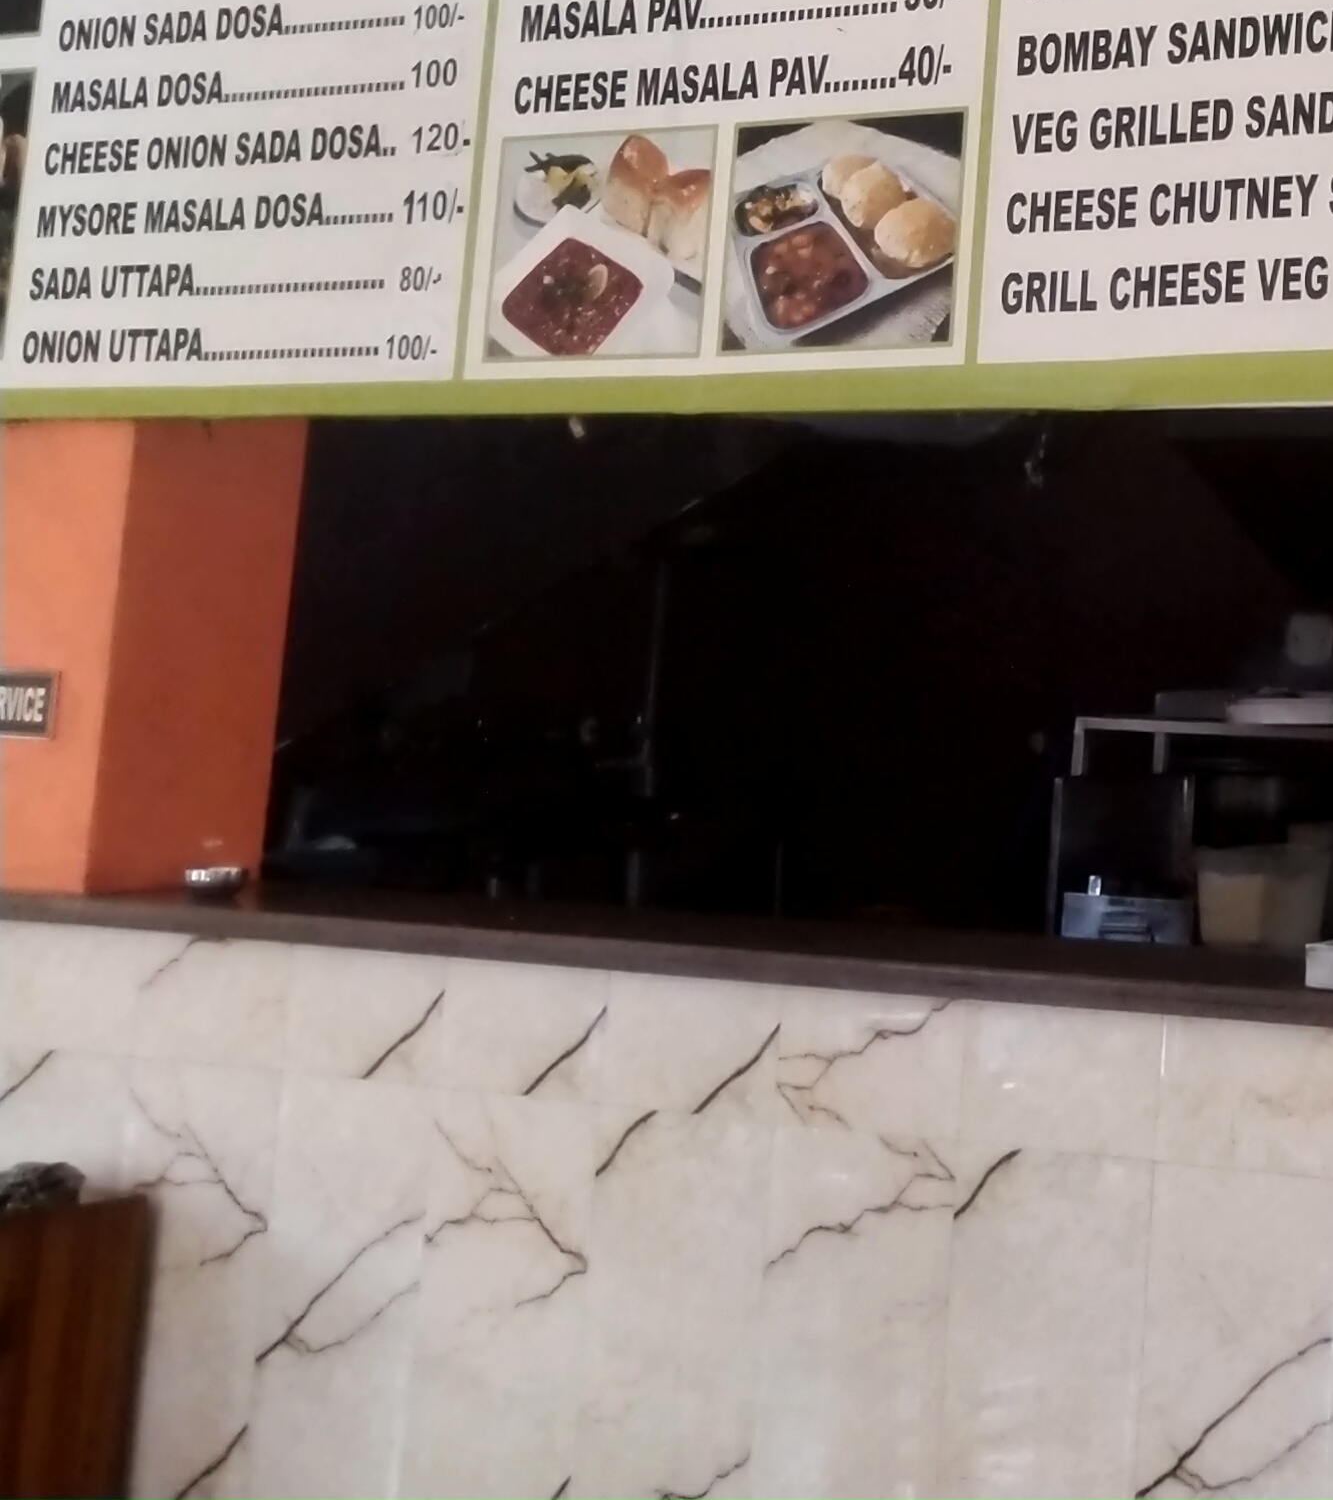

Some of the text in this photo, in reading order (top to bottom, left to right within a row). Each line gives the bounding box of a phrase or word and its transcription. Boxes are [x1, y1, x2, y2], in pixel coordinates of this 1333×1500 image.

[58, 14, 136, 52] ONION
[144, 9, 207, 44] SADA
[413, 3, 465, 30] 100/-
[1016, 25, 1158, 76] BOMBAY
[51, 76, 149, 114] MASALA
[411, 58, 457, 89] 100
[514, 69, 627, 114] CHEESE
[636, 61, 759, 107] MASALA
[898, 43, 952, 87] 40/-
[1012, 109, 1078, 155] VEG
[1089, 98, 1234, 150] GRILLED
[44, 138, 138, 176] CHEESE
[146, 133, 227, 171] ONION
[234, 129, 302, 163] SADA
[36, 201, 136, 238] MYSORE
[144, 196, 245, 232] MASALA
[403, 188, 464, 225] 110/-
[1006, 185, 1139, 235] CHEESE
[1149, 173, 1318, 227] CHUTNEY
[29, 266, 92, 301] SADA
[399, 265, 442, 292] 80/-
[1001, 270, 1098, 314] GRILL
[1109, 260, 1246, 311] CHEESE
[1257, 257, 1329, 302] VEG
[22, 329, 101, 364] ONION
[386, 334, 438, 361] 100/-
